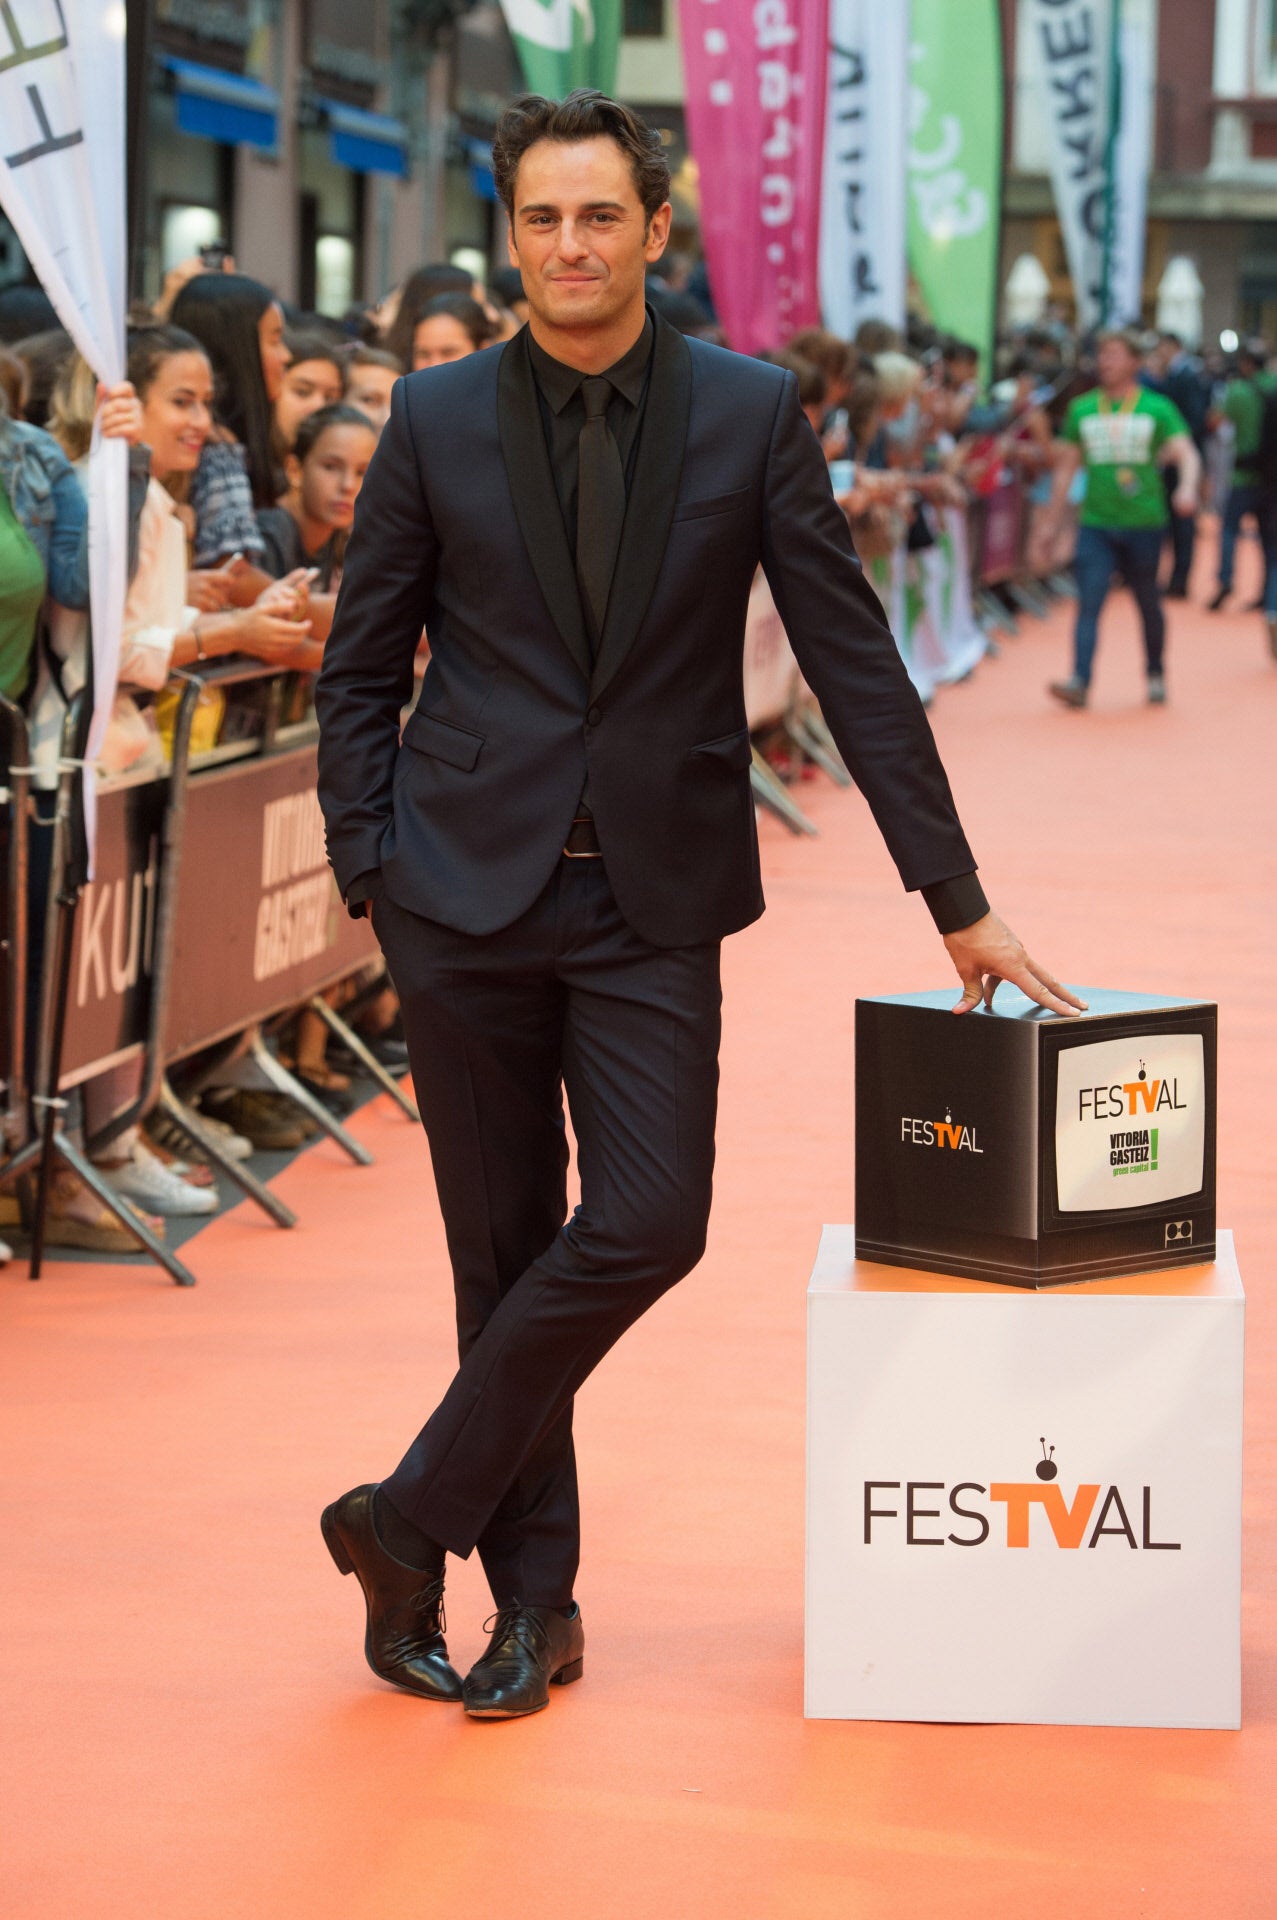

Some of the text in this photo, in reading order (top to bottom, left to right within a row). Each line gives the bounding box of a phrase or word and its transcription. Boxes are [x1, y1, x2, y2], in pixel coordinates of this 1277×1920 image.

[1078, 1077, 1187, 1122] FESTVAL
[901, 1116, 984, 1153] FESTVAL
[1109, 1129, 1150, 1149] VITORIA
[1109, 1146, 1150, 1166] GASTEIZ
[1112, 1162, 1149, 1177] green capital
[863, 1480, 1182, 1550] FESTVAL
